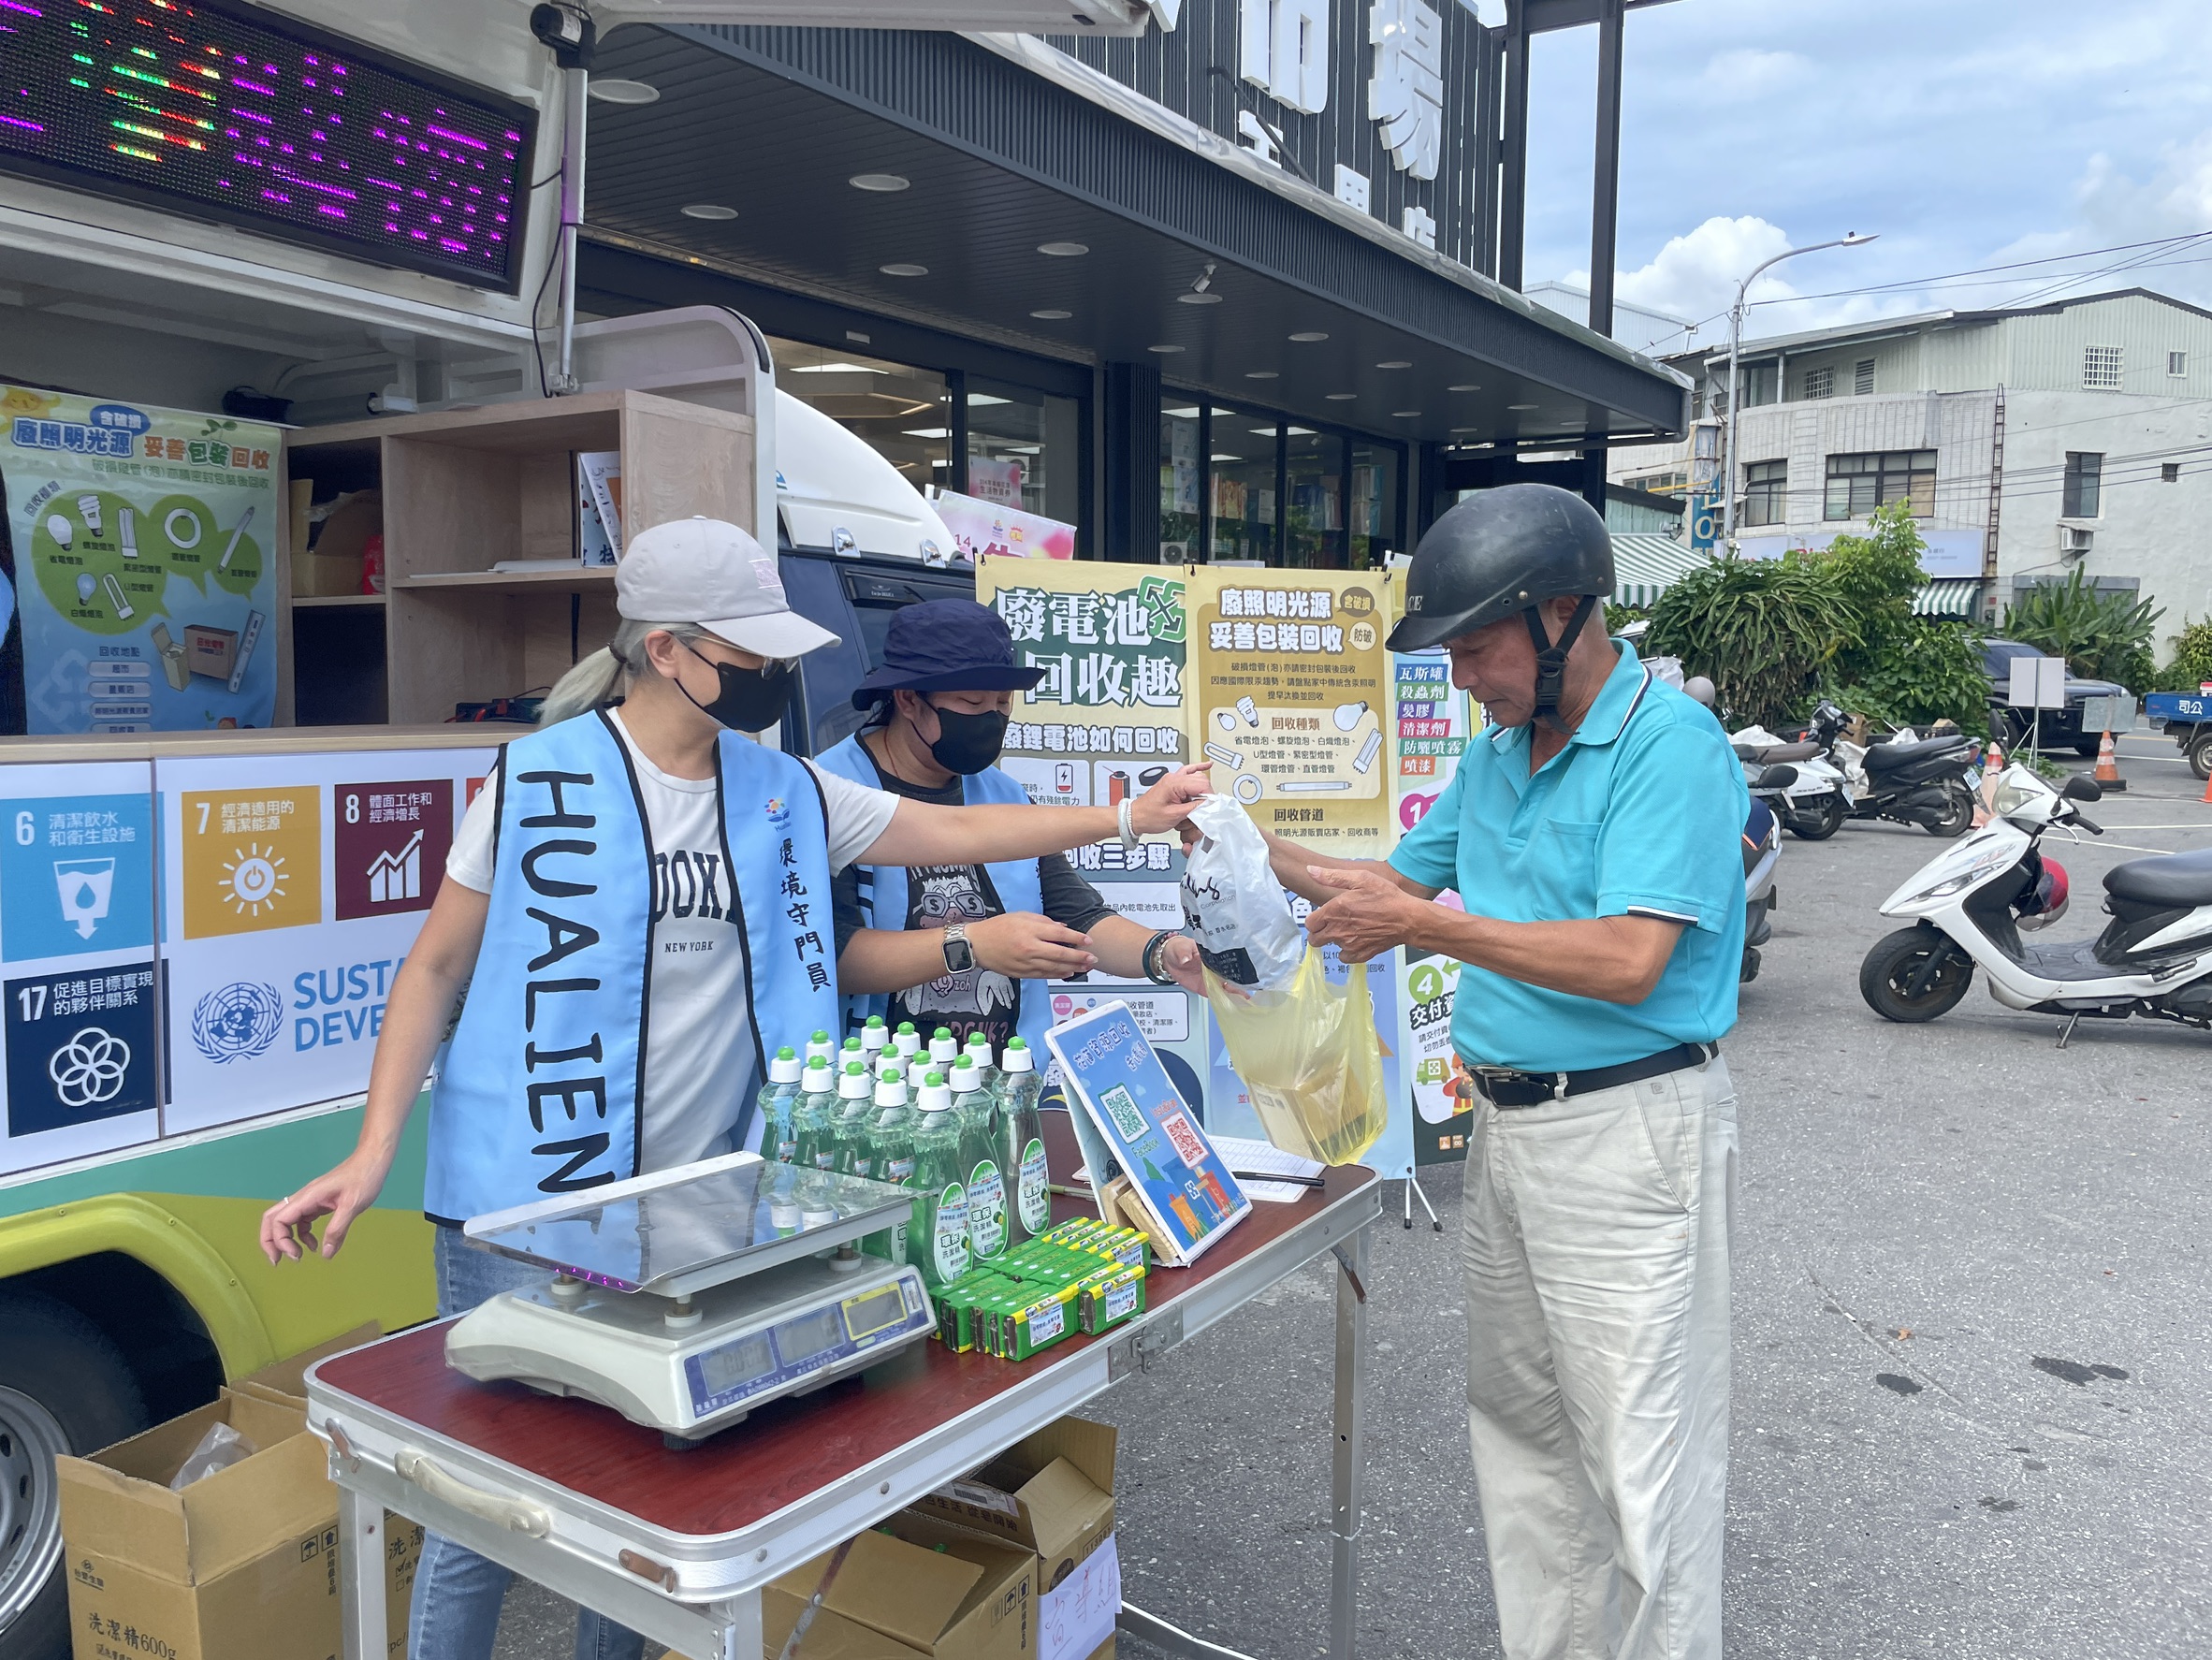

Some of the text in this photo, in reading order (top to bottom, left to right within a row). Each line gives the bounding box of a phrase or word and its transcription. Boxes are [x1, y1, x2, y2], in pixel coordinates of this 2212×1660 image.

[15, 418, 269, 470] 廢照明光源 妥善包裝回收
[1221, 589, 1332, 618] 廢照明光源
[1345, 595, 1370, 610] 含破損
[997, 590, 1152, 645] 廢電池
[1211, 622, 1342, 652] 妥善包裝回收
[1354, 629, 1372, 643] 防破
[99, 647, 140, 657] 回收地點
[1231, 663, 1356, 674] 破損燈管(泡)亦請密封包裝後回收
[1400, 666, 1444, 681] 瓦斯罐
[1025, 652, 1182, 707] 回收趣
[1268, 691, 1324, 701] 提早汰換並回收
[1400, 685, 1445, 700] 殺蟲劑
[1403, 704, 1430, 718] 髮膠
[1272, 717, 1320, 731] 回收種類
[1403, 721, 1447, 736] 清潔劑
[1002, 721, 1179, 754] 廢鋰電池如何回收
[1404, 740, 1463, 754] 防曬噴霧
[1404, 759, 1432, 773] 噴漆
[370, 792, 432, 808] 體面工作和
[221, 800, 295, 819] 經濟適用的
[345, 794, 360, 824] 8
[370, 807, 420, 823] 經濟增長
[1274, 808, 1324, 822] 回收管道
[49, 810, 119, 829] 清潔飲水
[196, 803, 211, 834] 7
[222, 815, 281, 834] 清潔能源
[16, 811, 35, 846] 6
[49, 826, 136, 847] 和衛生設施
[779, 837, 831, 992] 環境守門員
[665, 940, 714, 953] NEW YORK
[53, 971, 153, 999] 促進目標實現
[517, 770, 618, 1194] HUALIEN
[1417, 973, 1433, 995] 4
[19, 985, 48, 1022] 17
[971, 1206, 992, 1222] 環保
[973, 1221, 992, 1232] 洗潔精
[940, 1233, 960, 1248] 環保
[942, 1246, 960, 1259] 洗潔精
